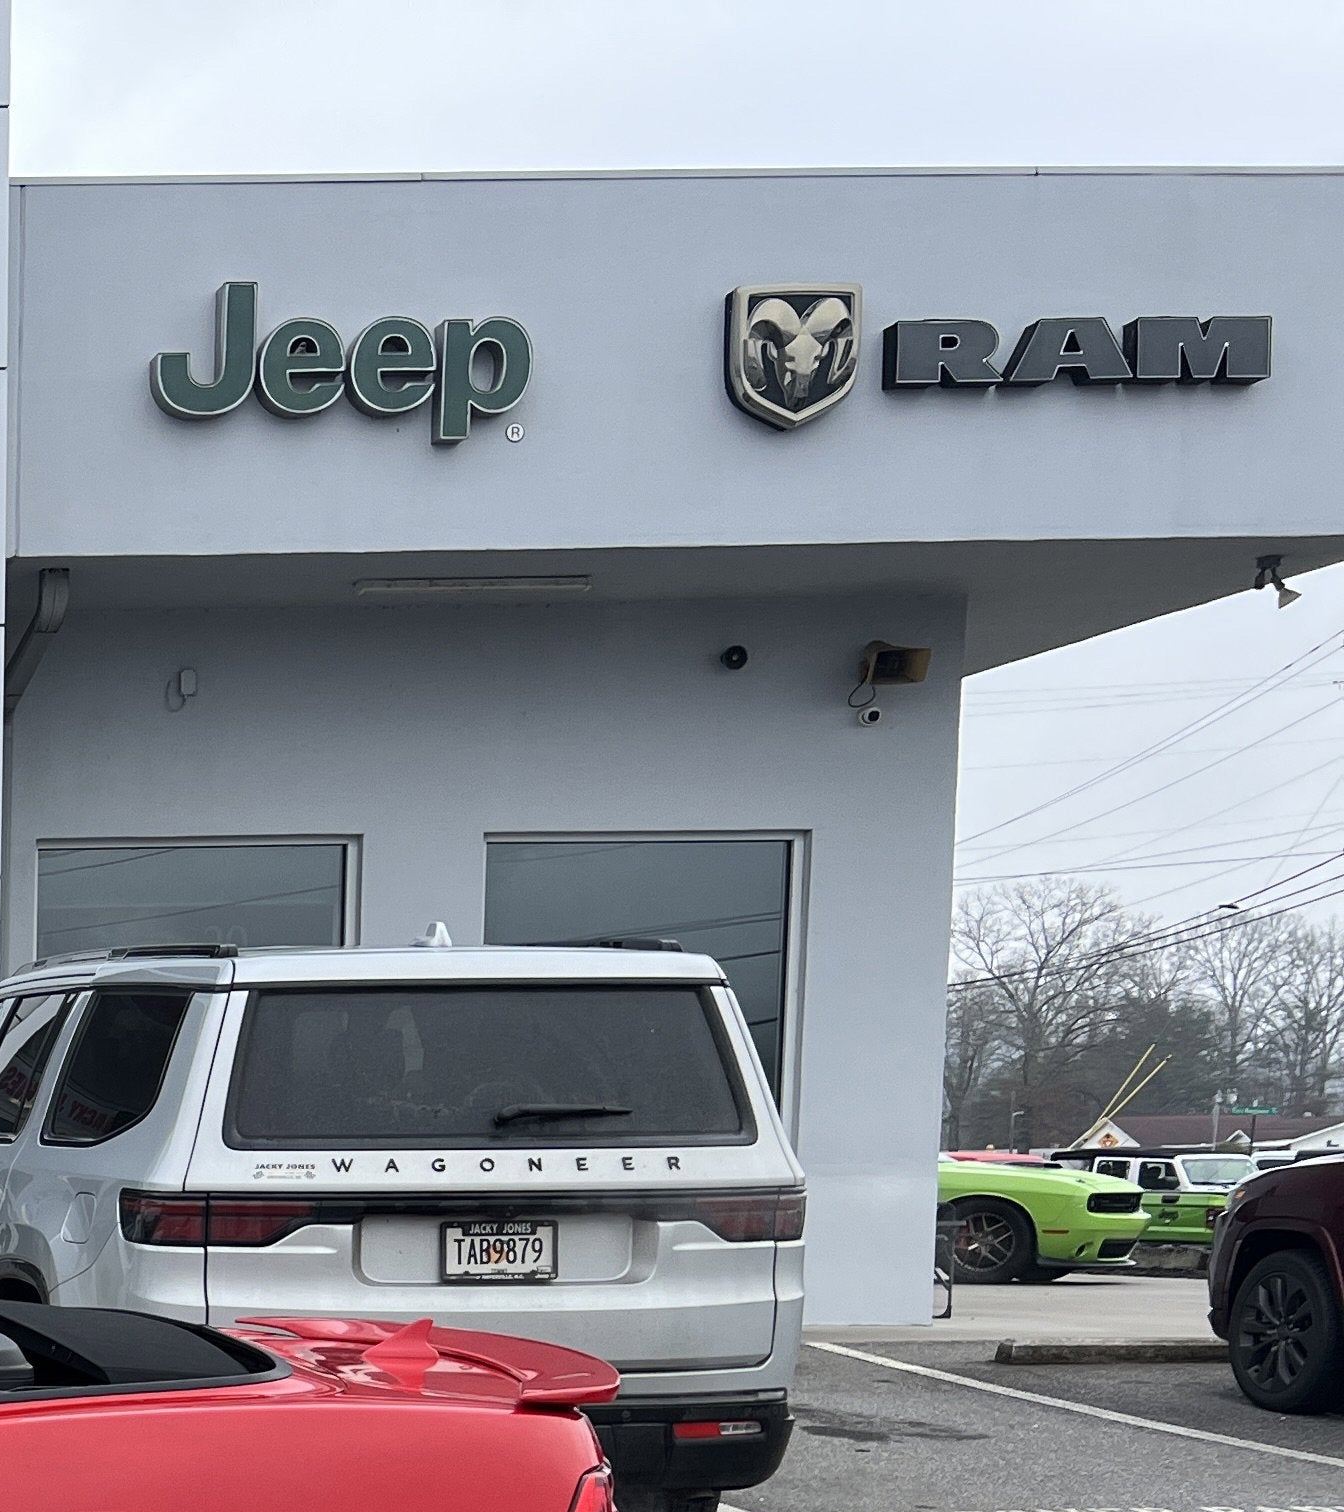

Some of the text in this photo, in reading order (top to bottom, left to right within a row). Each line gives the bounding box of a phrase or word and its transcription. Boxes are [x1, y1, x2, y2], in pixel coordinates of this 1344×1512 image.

[149, 281, 534, 446] Jeep
[881, 316, 1273, 391] RAM
[331, 1156, 682, 1174] WAGONEER
[470, 1223, 531, 1233] JACKY JONES
[454, 1238, 543, 1265] TAB9879
